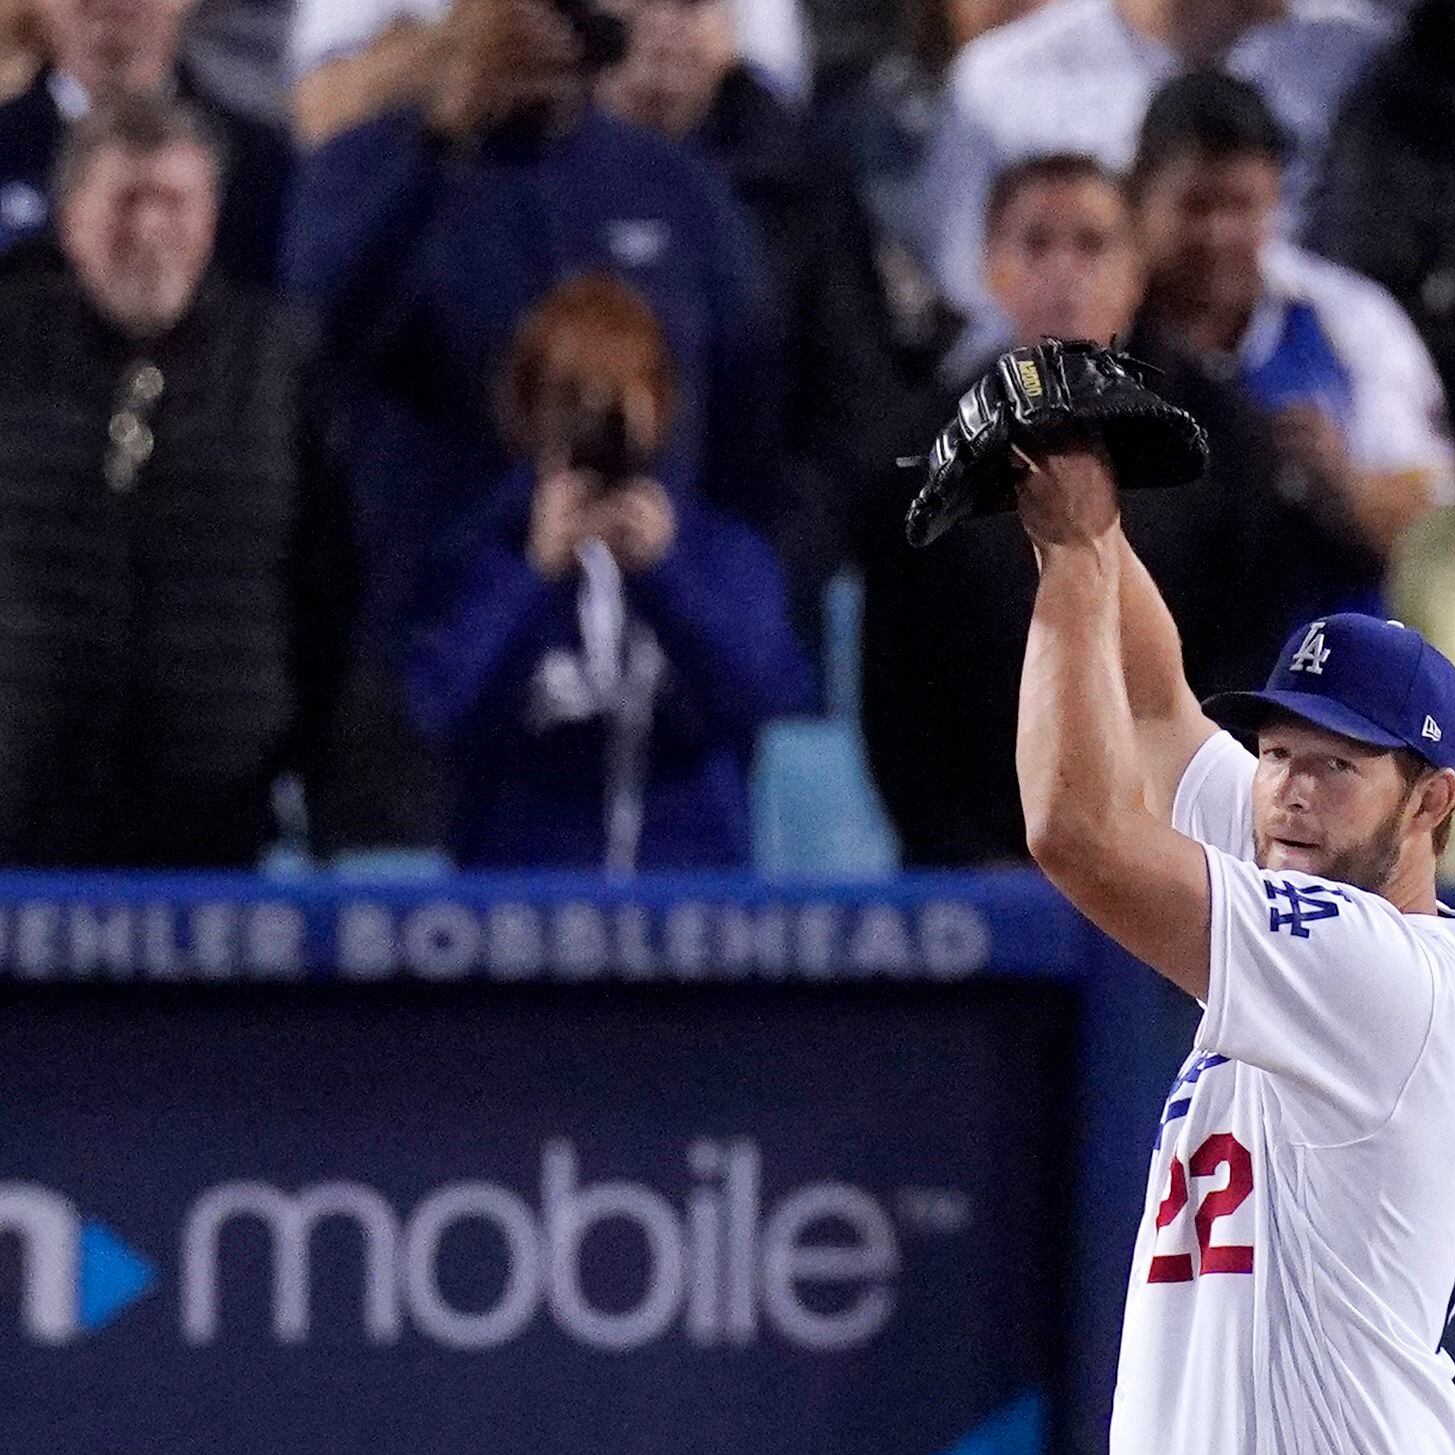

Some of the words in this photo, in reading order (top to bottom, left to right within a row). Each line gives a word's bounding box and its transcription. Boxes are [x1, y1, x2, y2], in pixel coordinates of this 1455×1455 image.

[1289, 621, 1331, 675] LA
[0, 902, 304, 982] EHLER
[338, 900, 992, 982] BOBBLEHEAD
[182, 1136, 902, 1350] mobile
[1147, 1132, 1254, 1284] 22
